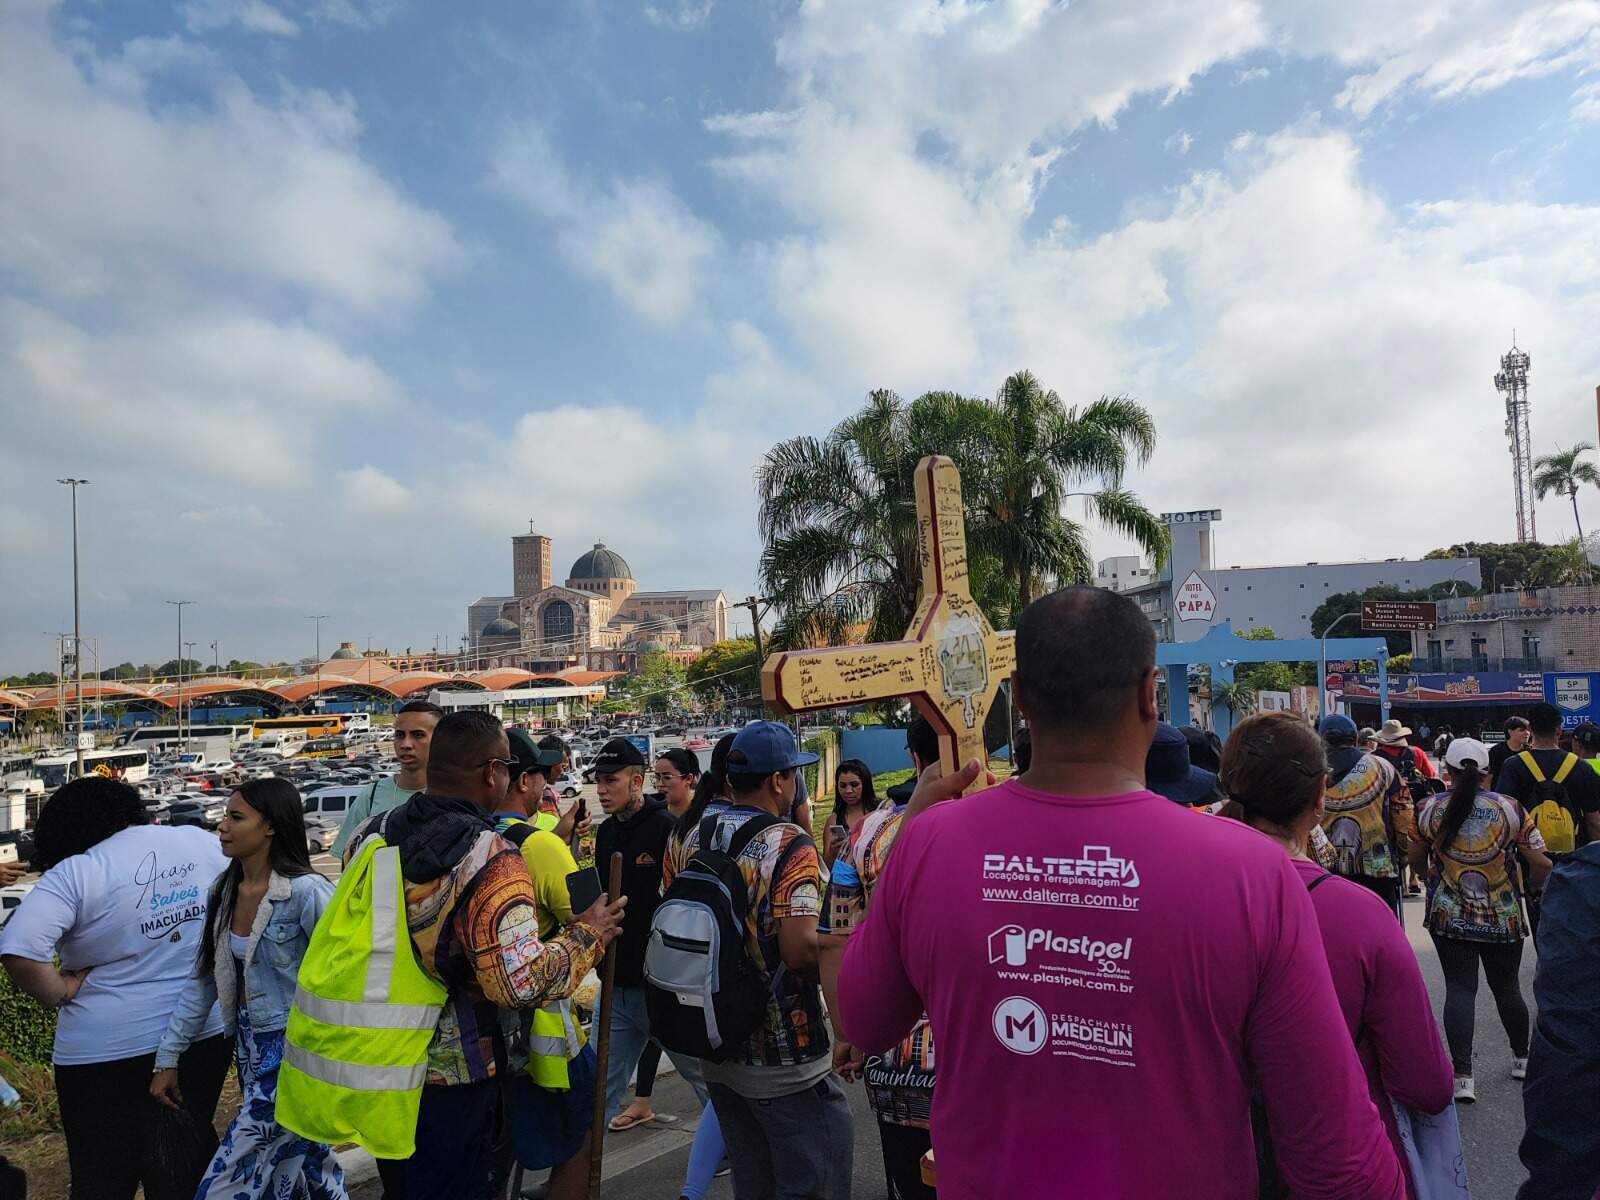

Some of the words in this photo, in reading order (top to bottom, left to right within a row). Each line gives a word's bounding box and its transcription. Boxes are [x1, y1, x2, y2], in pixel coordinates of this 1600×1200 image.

[1161, 510, 1218, 522] HOTEL
[1185, 583, 1202, 591] HOTEL
[1178, 600, 1212, 612] PAPA
[1567, 680, 1578, 688] SP
[1558, 693, 1589, 702] BR-488
[80, 736, 94, 746] C-10
[135, 850, 196, 909] Acaso
[983, 853, 1140, 888] DALTERRA
[983, 871, 1031, 882] Locações
[1033, 874, 1040, 882] e
[1043, 873, 1120, 888] Terraplenagem
[150, 885, 198, 911] Sabeis
[982, 887, 1139, 908] www.dalterra.com.br
[141, 904, 206, 935] IMACULADA
[1026, 928, 1133, 962] Plastpel
[1096, 958, 1117, 974] 50
[997, 971, 1134, 994] www.plastpel.com.br
[1051, 1013, 1133, 1033] DESPACHANTE
[1051, 1021, 1134, 1049] MEDELIN
